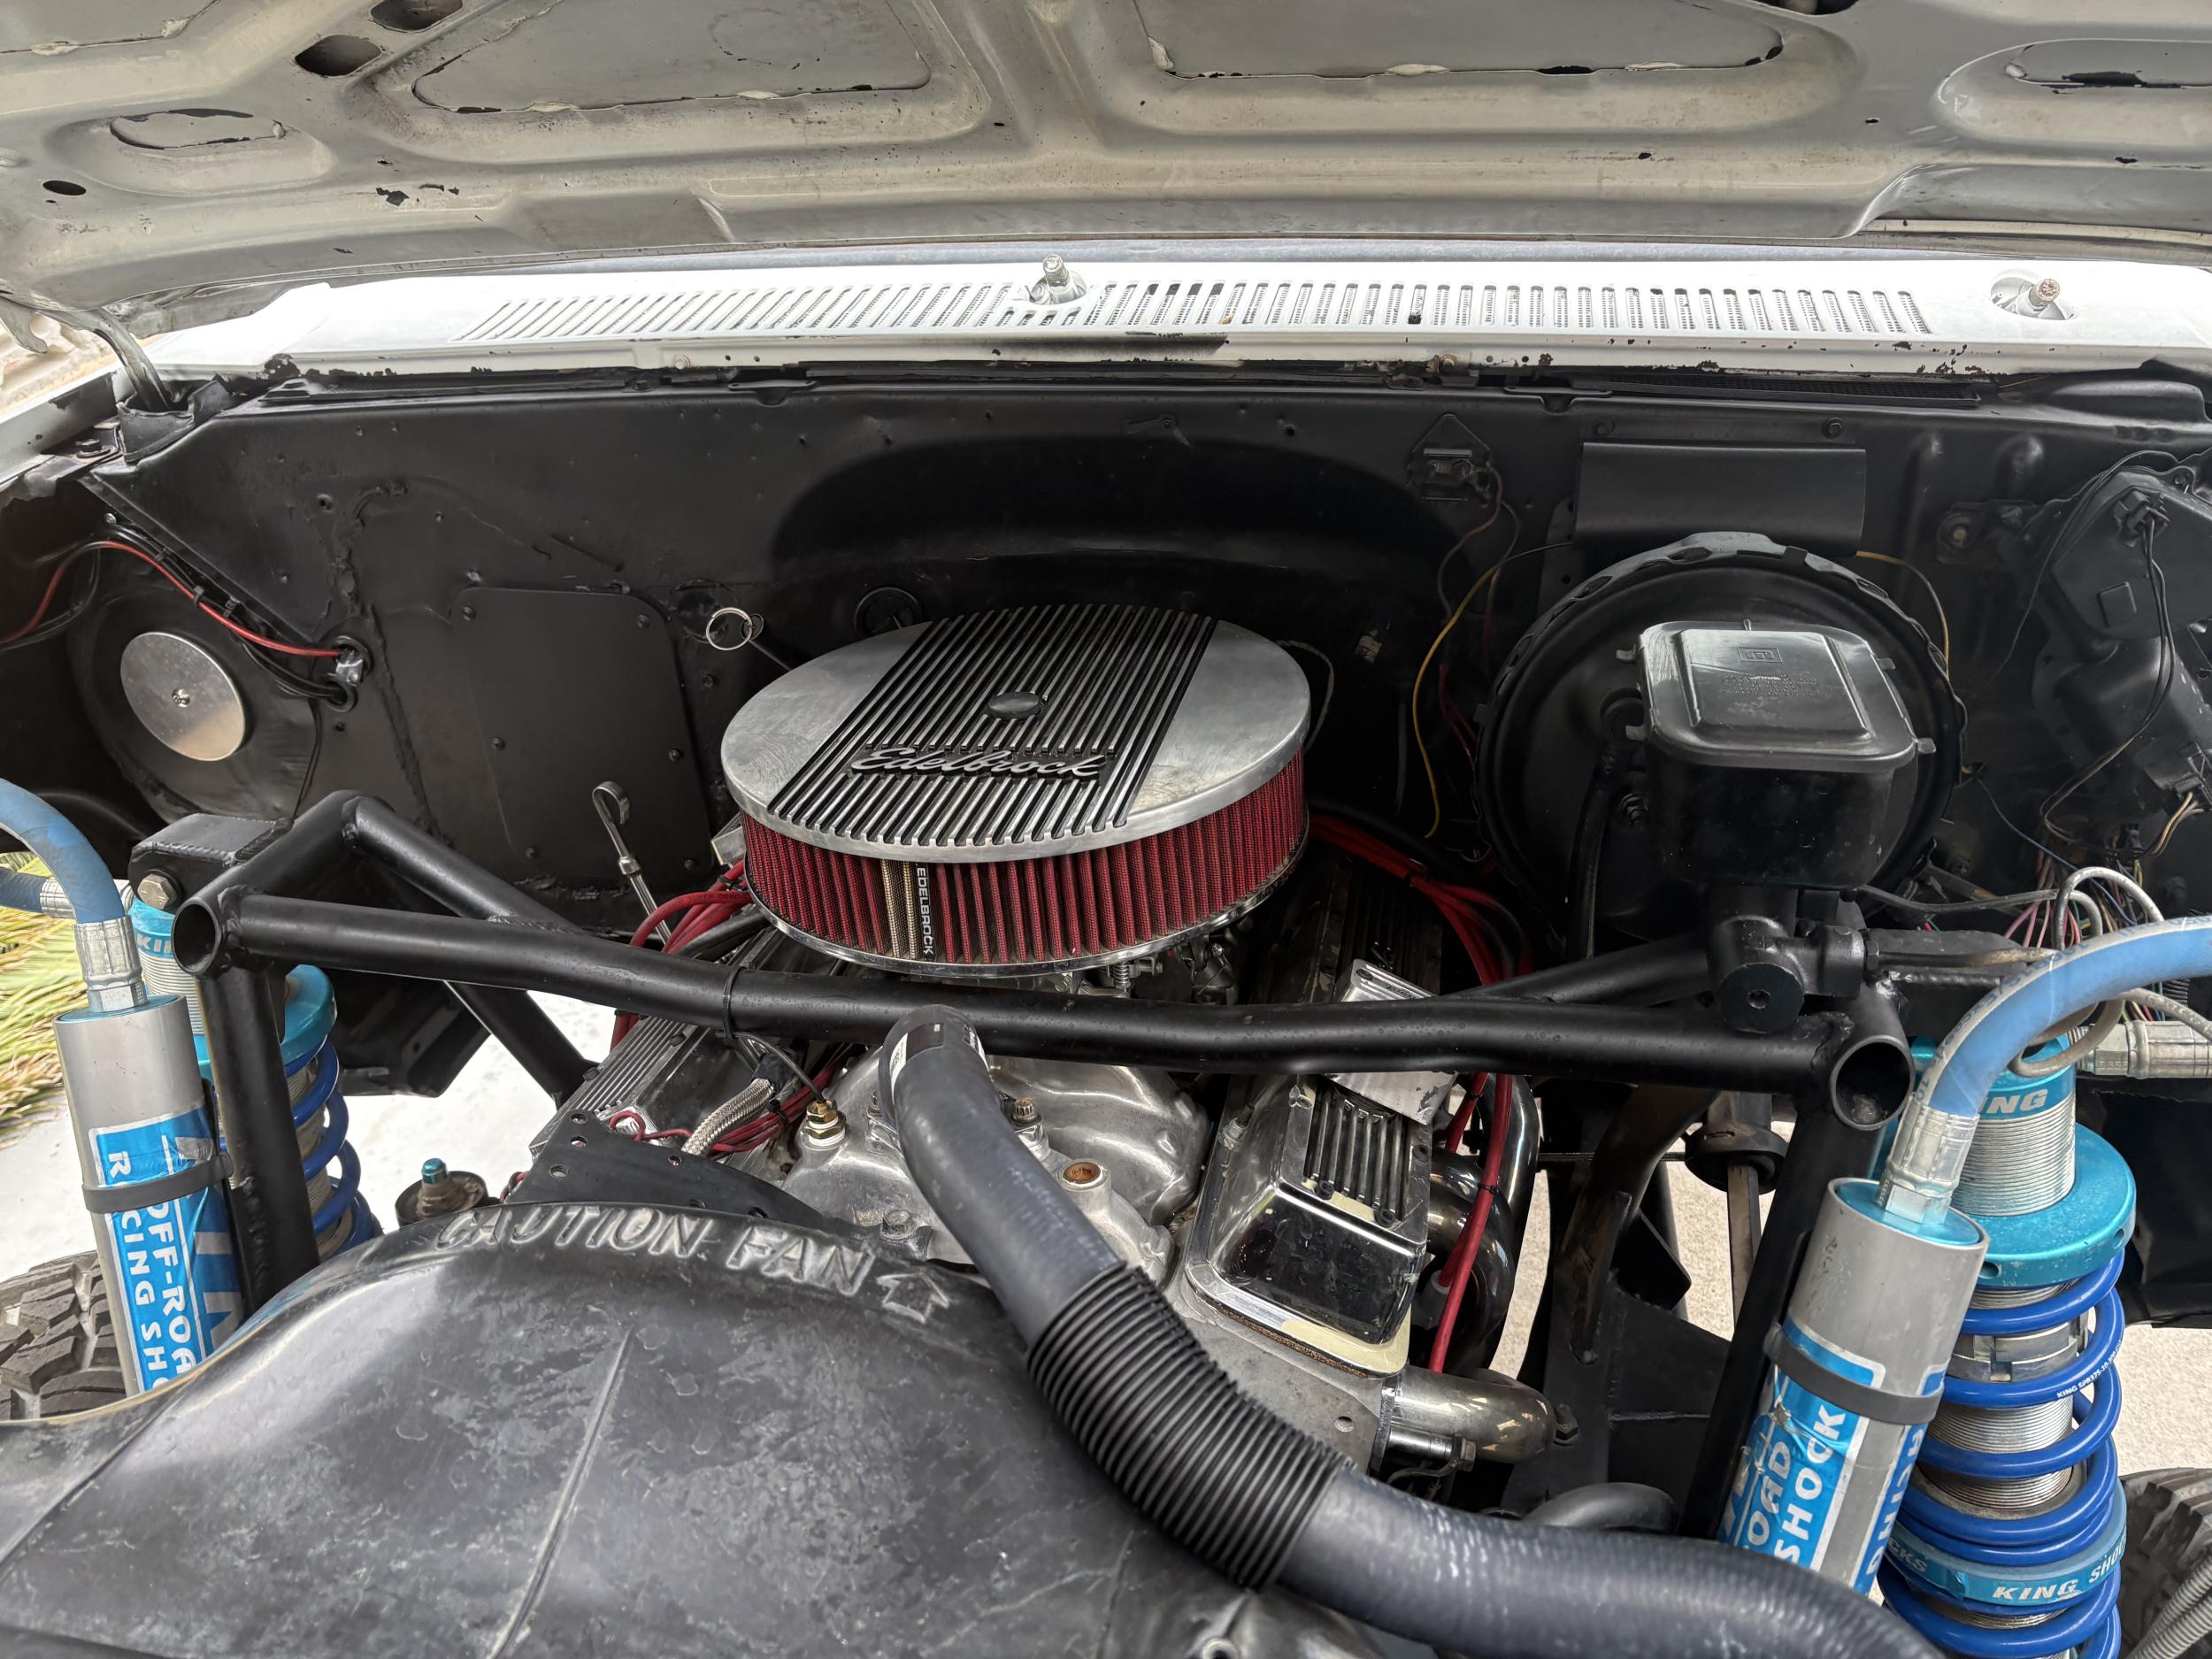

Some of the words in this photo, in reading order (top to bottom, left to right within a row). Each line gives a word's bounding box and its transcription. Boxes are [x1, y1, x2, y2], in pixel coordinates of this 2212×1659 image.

[850, 747, 1106, 780] Edelbrock
[917, 867, 933, 956] EDELBROCK
[1985, 1088, 2048, 1114] NG
[107, 1150, 156, 1306] RCING
[435, 1205, 713, 1258] CAUTION
[726, 1226, 877, 1297] FAN
[146, 1201, 196, 1374] OFF-ROA
[2056, 1385, 2078, 1398] KING
[1747, 1440, 1792, 1547] OAD
[1992, 1578, 2079, 1601] KING
